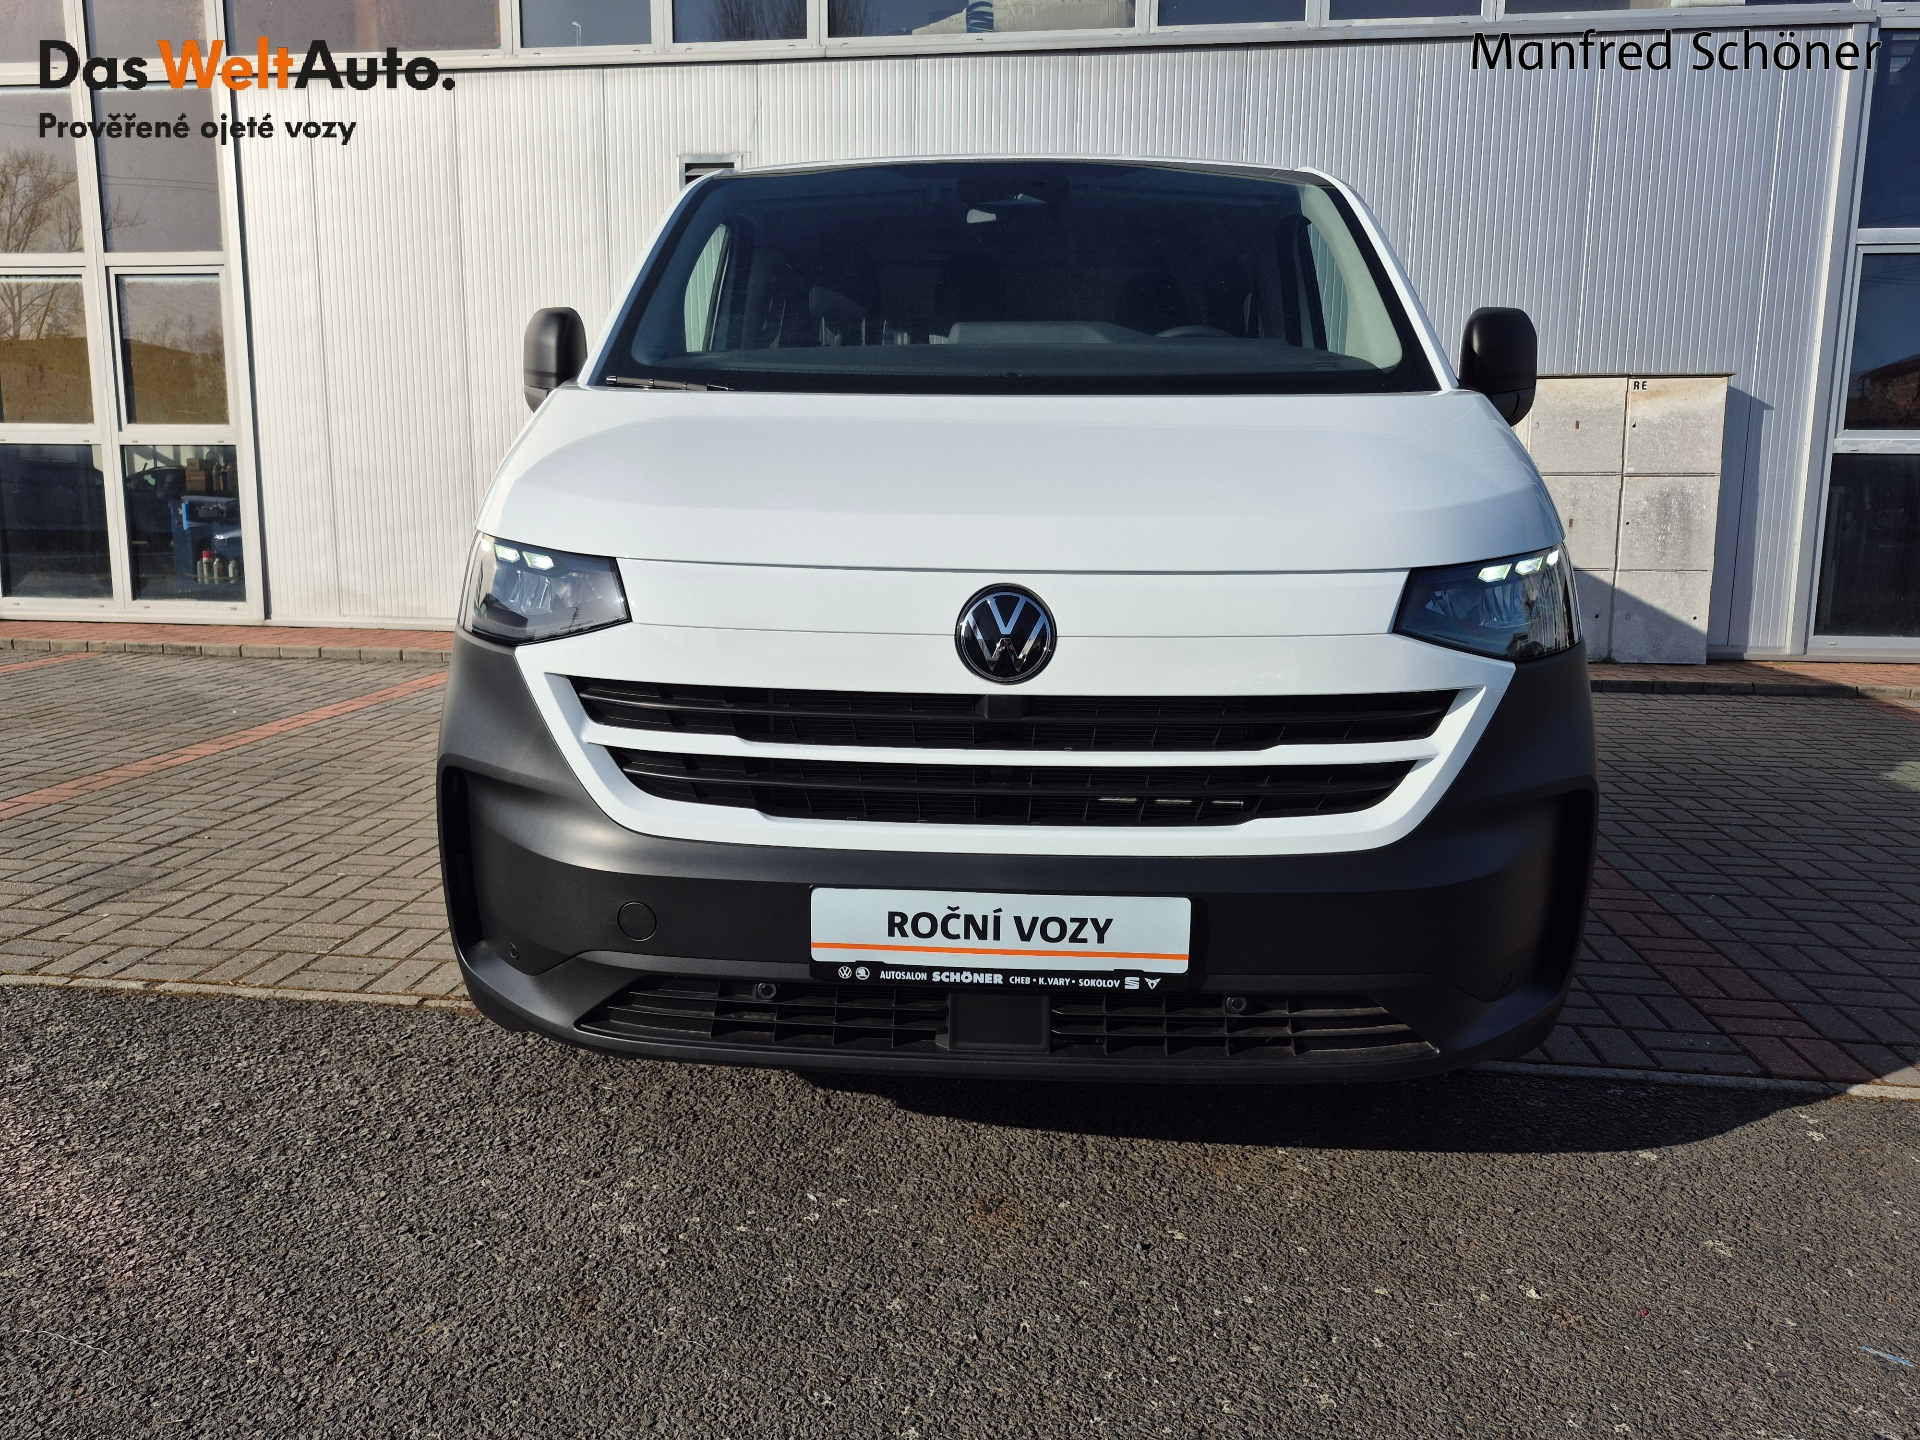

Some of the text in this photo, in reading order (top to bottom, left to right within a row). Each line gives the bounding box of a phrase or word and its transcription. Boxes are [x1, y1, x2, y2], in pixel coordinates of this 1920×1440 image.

[1633, 380, 1648, 390] RE
[887, 905, 1114, 944] ROČNÍ VOZY
[880, 970, 928, 981] AUTOSALON
[931, 971, 1003, 984] SCHÖNER
[1009, 976, 1031, 985] CHEB
[1078, 978, 1121, 988] SOKOLOV
